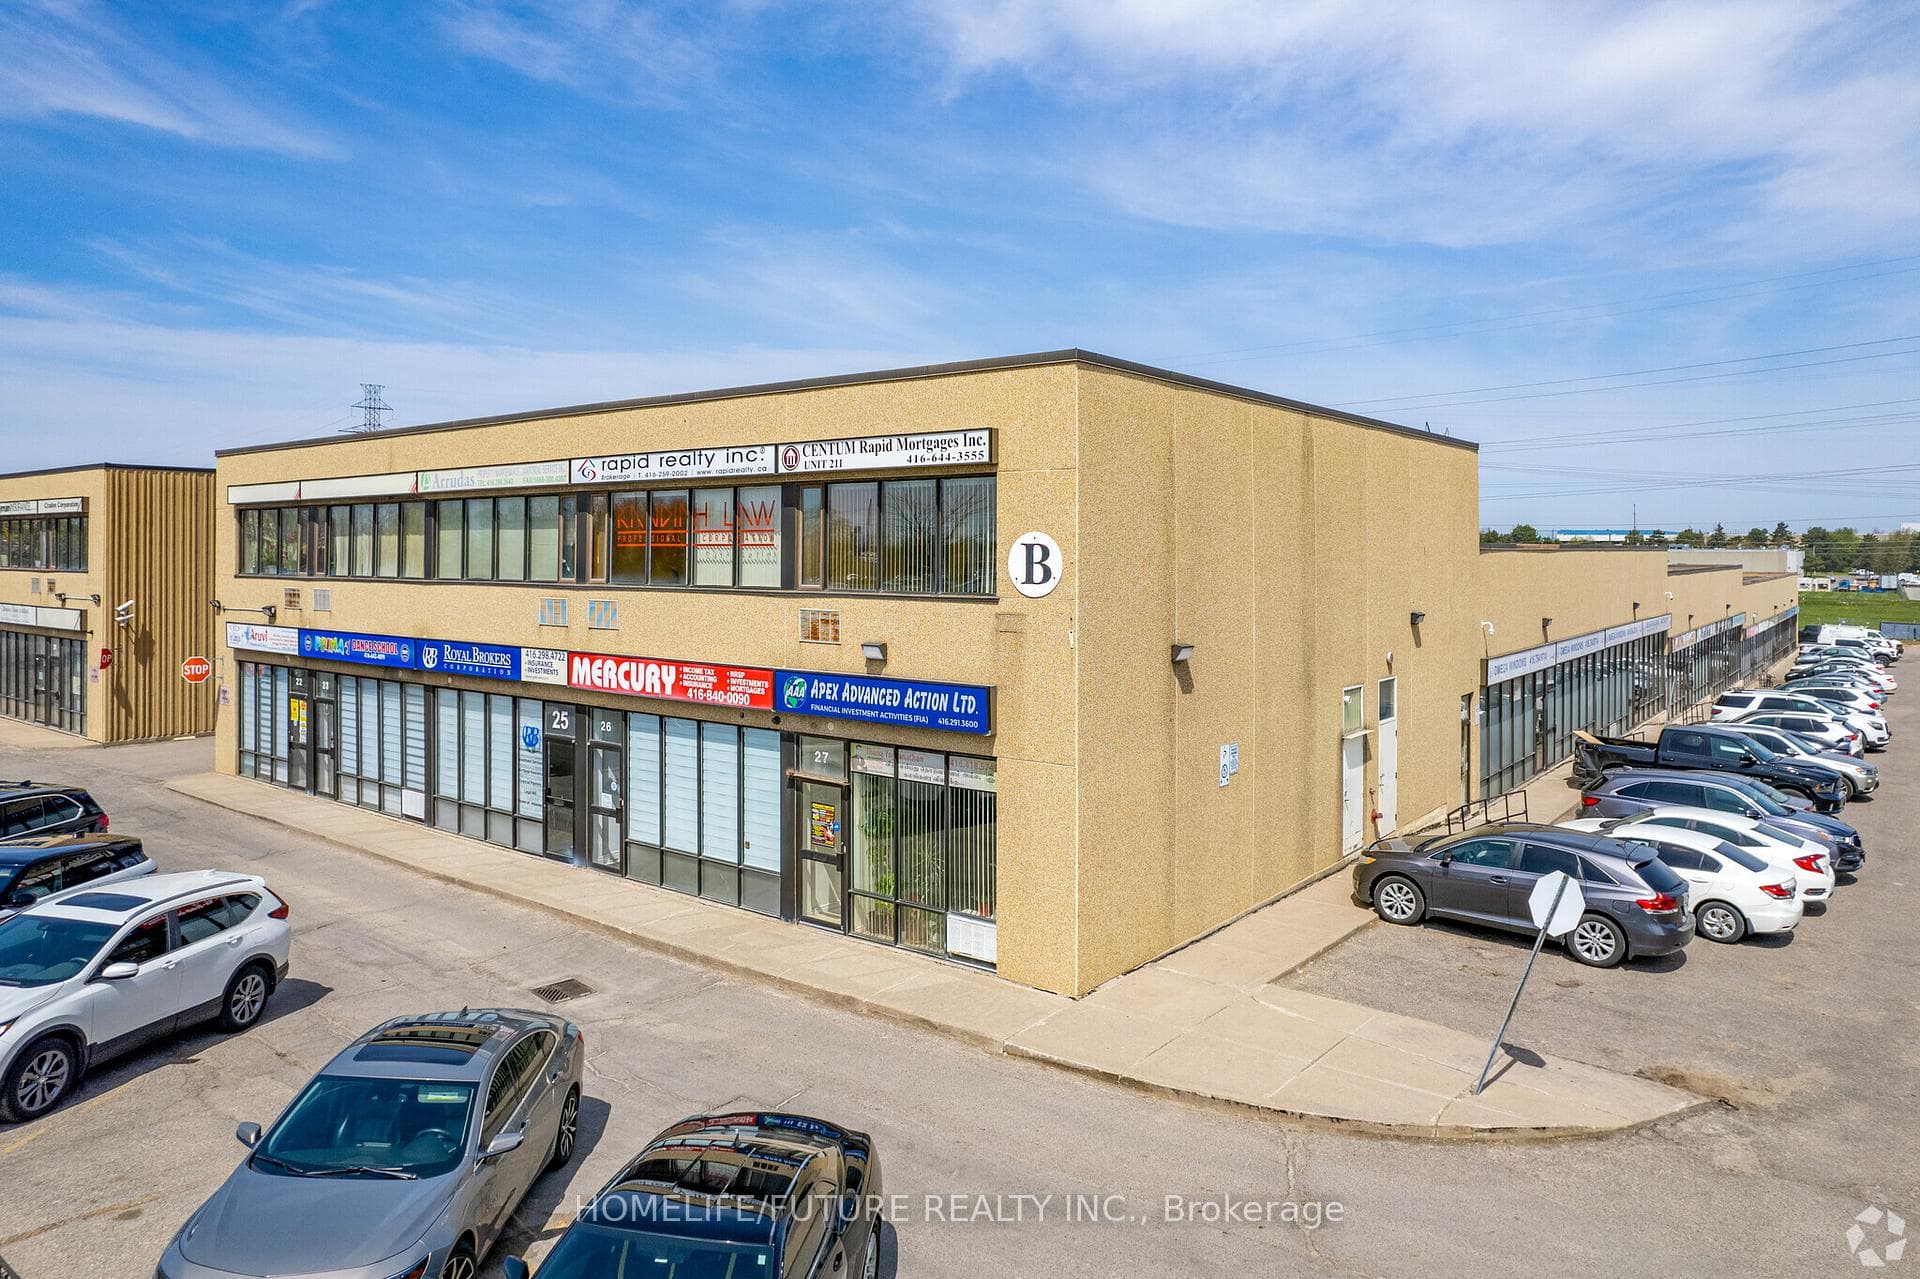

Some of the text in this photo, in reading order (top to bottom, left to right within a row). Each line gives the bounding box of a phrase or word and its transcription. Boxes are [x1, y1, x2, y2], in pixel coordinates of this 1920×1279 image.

[802, 433, 986, 457] CENTUM Rapid Mortgages Inc.
[601, 454, 649, 472] rapid
[659, 449, 715, 468] realty
[804, 459, 828, 469] UNIT
[906, 450, 985, 464] 416-644-3555
[432, 471, 475, 489] Arrudas
[601, 473, 631, 481] Brokerage
[1020, 543, 1051, 584] B
[351, 639, 399, 655] DANCE SCHOOL
[443, 644, 511, 665] ROYAL BROKERS
[525, 650, 566, 661] 416.298.4722
[184, 664, 209, 675] STOP
[443, 663, 511, 675] CORPORATION
[527, 660, 554, 668] INSURANCE
[527, 667, 559, 676] INVESTMENTS
[571, 656, 676, 695] MERCURY
[295, 678, 303, 686] 22
[810, 679, 839, 700] APEX
[841, 682, 900, 706] ADVANCED
[904, 687, 949, 712] ACTION
[552, 711, 569, 729] 25
[811, 704, 929, 724] FINANCIAL INVESTMENT ACTIVITIES (FIA)
[601, 721, 612, 732] 26
[814, 751, 829, 763] 27
